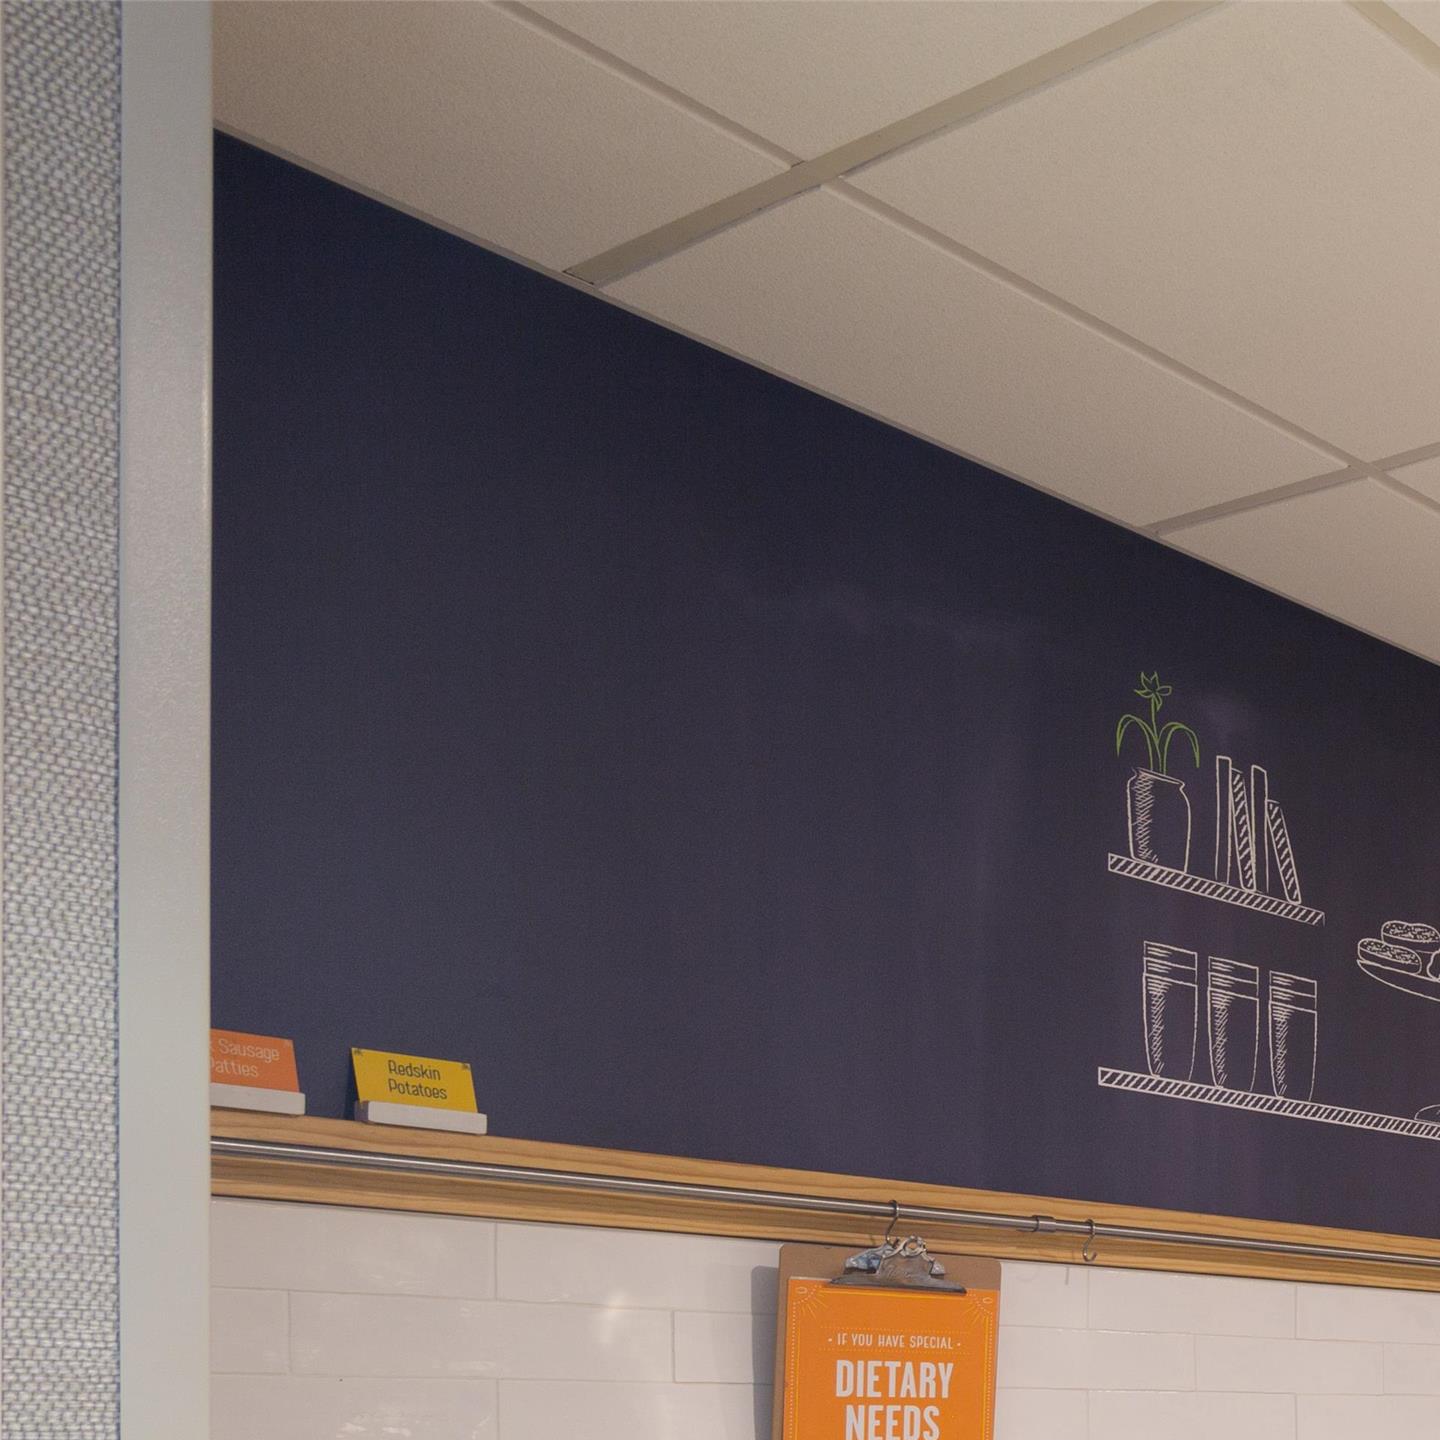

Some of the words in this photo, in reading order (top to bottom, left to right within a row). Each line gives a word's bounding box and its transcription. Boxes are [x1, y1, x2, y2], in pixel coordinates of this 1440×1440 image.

[218, 1038, 280, 1063] Sausage
[388, 1060, 441, 1081] Redskin
[388, 1078, 448, 1100] Potatoes
[836, 1333, 849, 1345] IF
[852, 1333, 873, 1346] YOU
[877, 1335, 905, 1348] HAVE
[909, 1336, 954, 1349] SPECIAL
[835, 1360, 954, 1399] DIETARY
